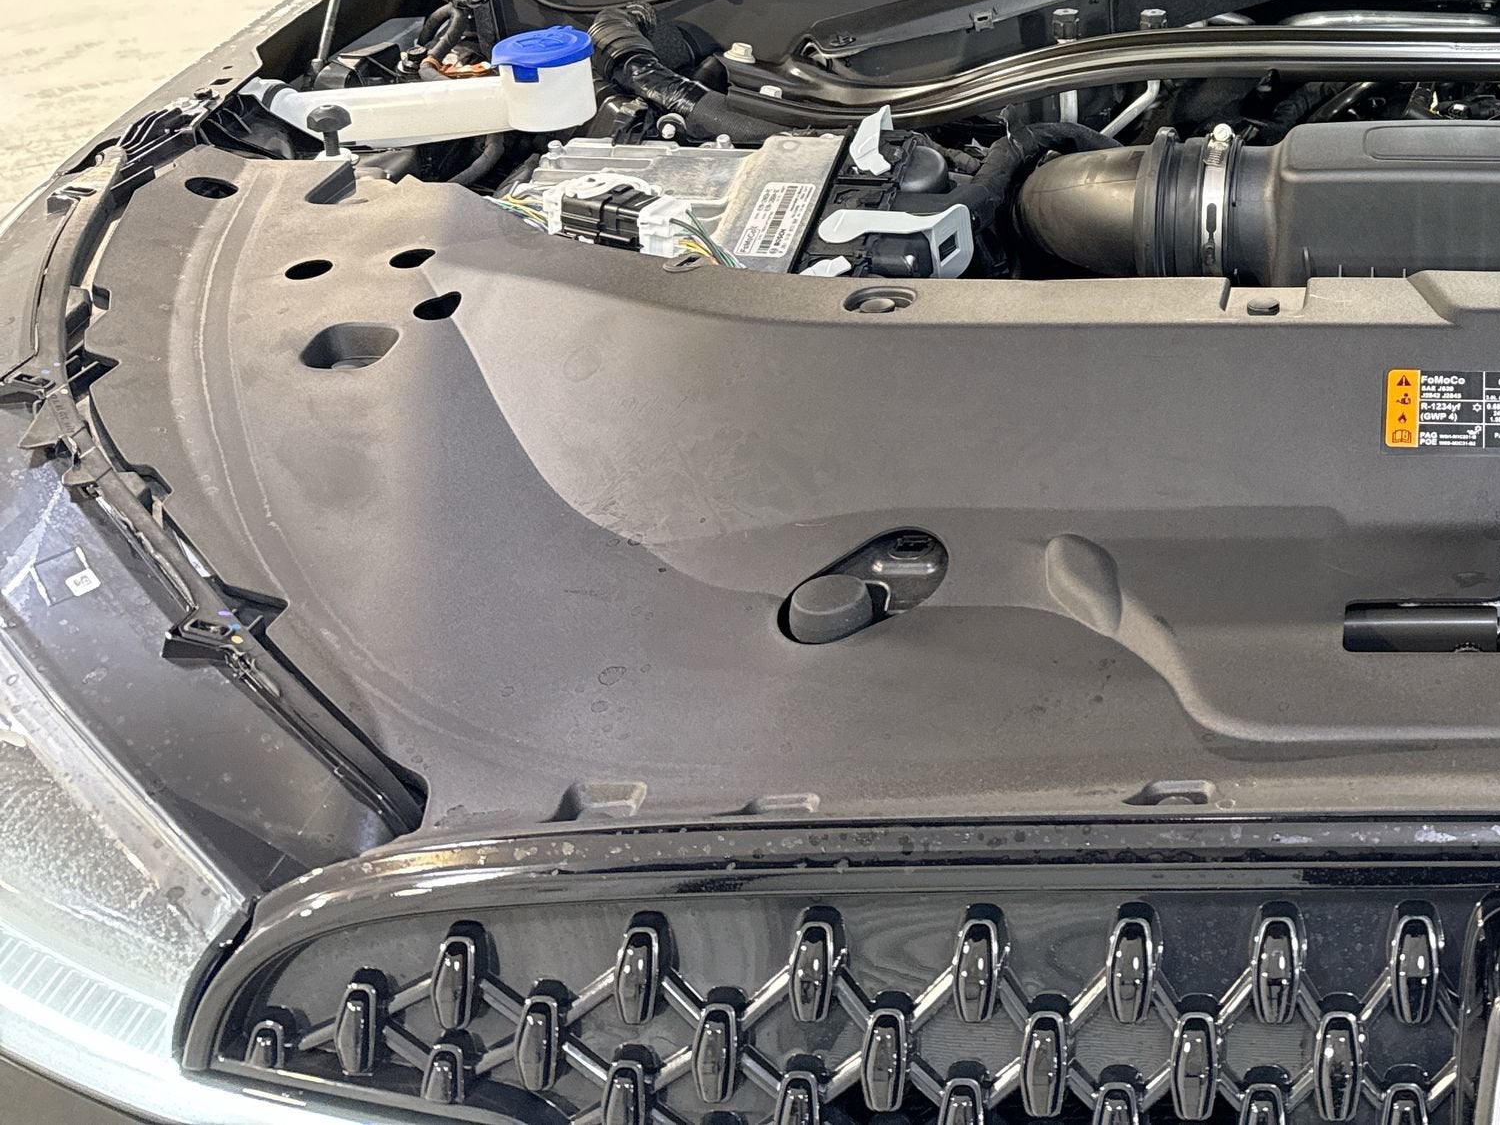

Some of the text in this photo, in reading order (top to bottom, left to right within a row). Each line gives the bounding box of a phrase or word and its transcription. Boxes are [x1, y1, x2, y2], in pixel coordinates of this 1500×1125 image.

[773, 228, 787, 246] BOSCH
[1421, 375, 1466, 385] FoMoCo
[1420, 402, 1461, 412] R-1234yf
[1420, 412, 1458, 422] (GWP 4)
[1420, 431, 1438, 439] PAG
[1420, 438, 1438, 446] POE
